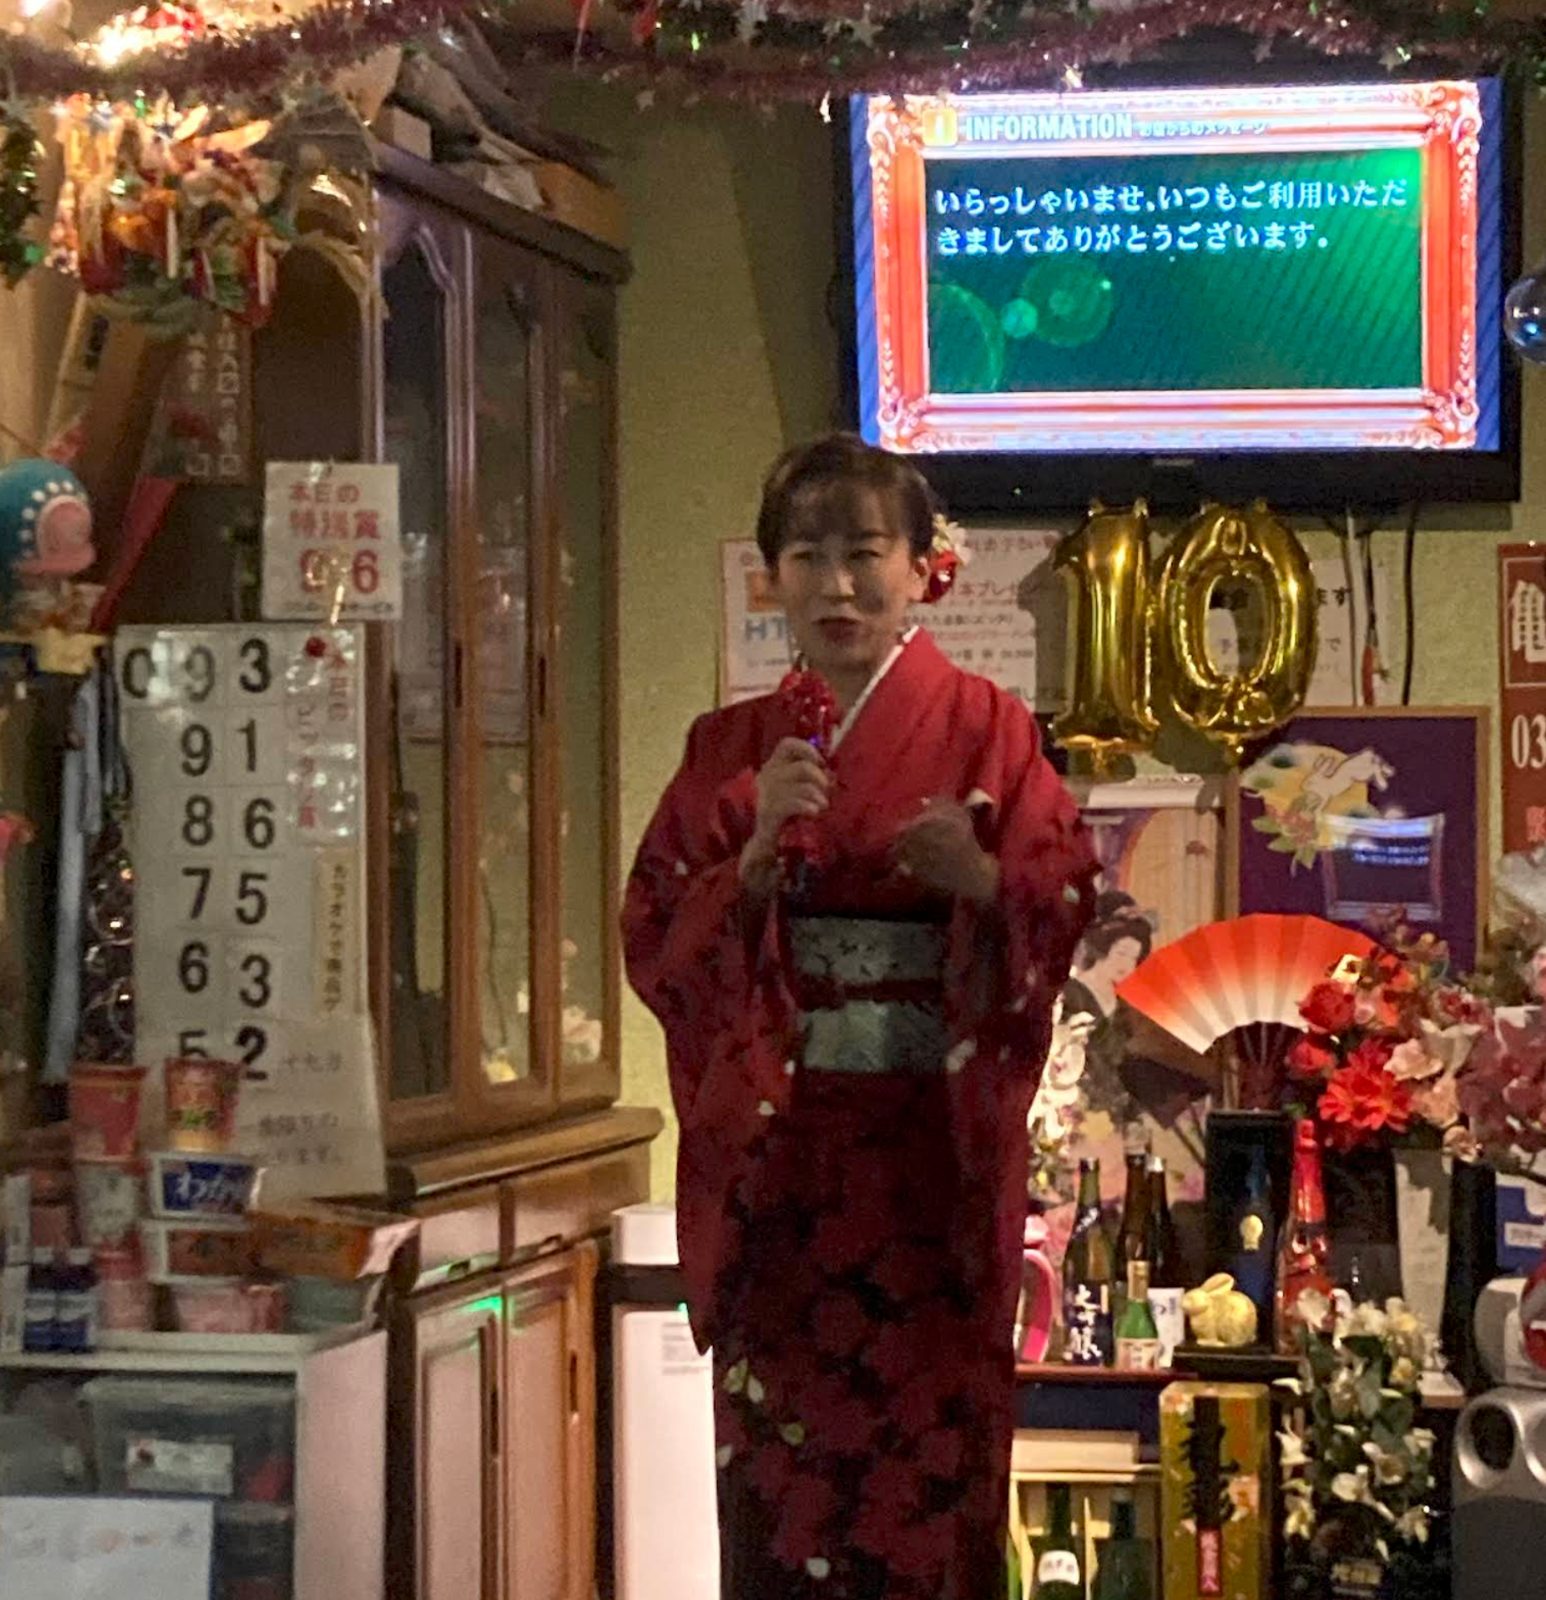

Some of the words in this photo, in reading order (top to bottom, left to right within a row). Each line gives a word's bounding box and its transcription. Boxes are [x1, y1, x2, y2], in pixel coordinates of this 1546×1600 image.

[964, 112, 1133, 142] INFORMATION
[937, 220, 1329, 255] きましてありがとうございます。
